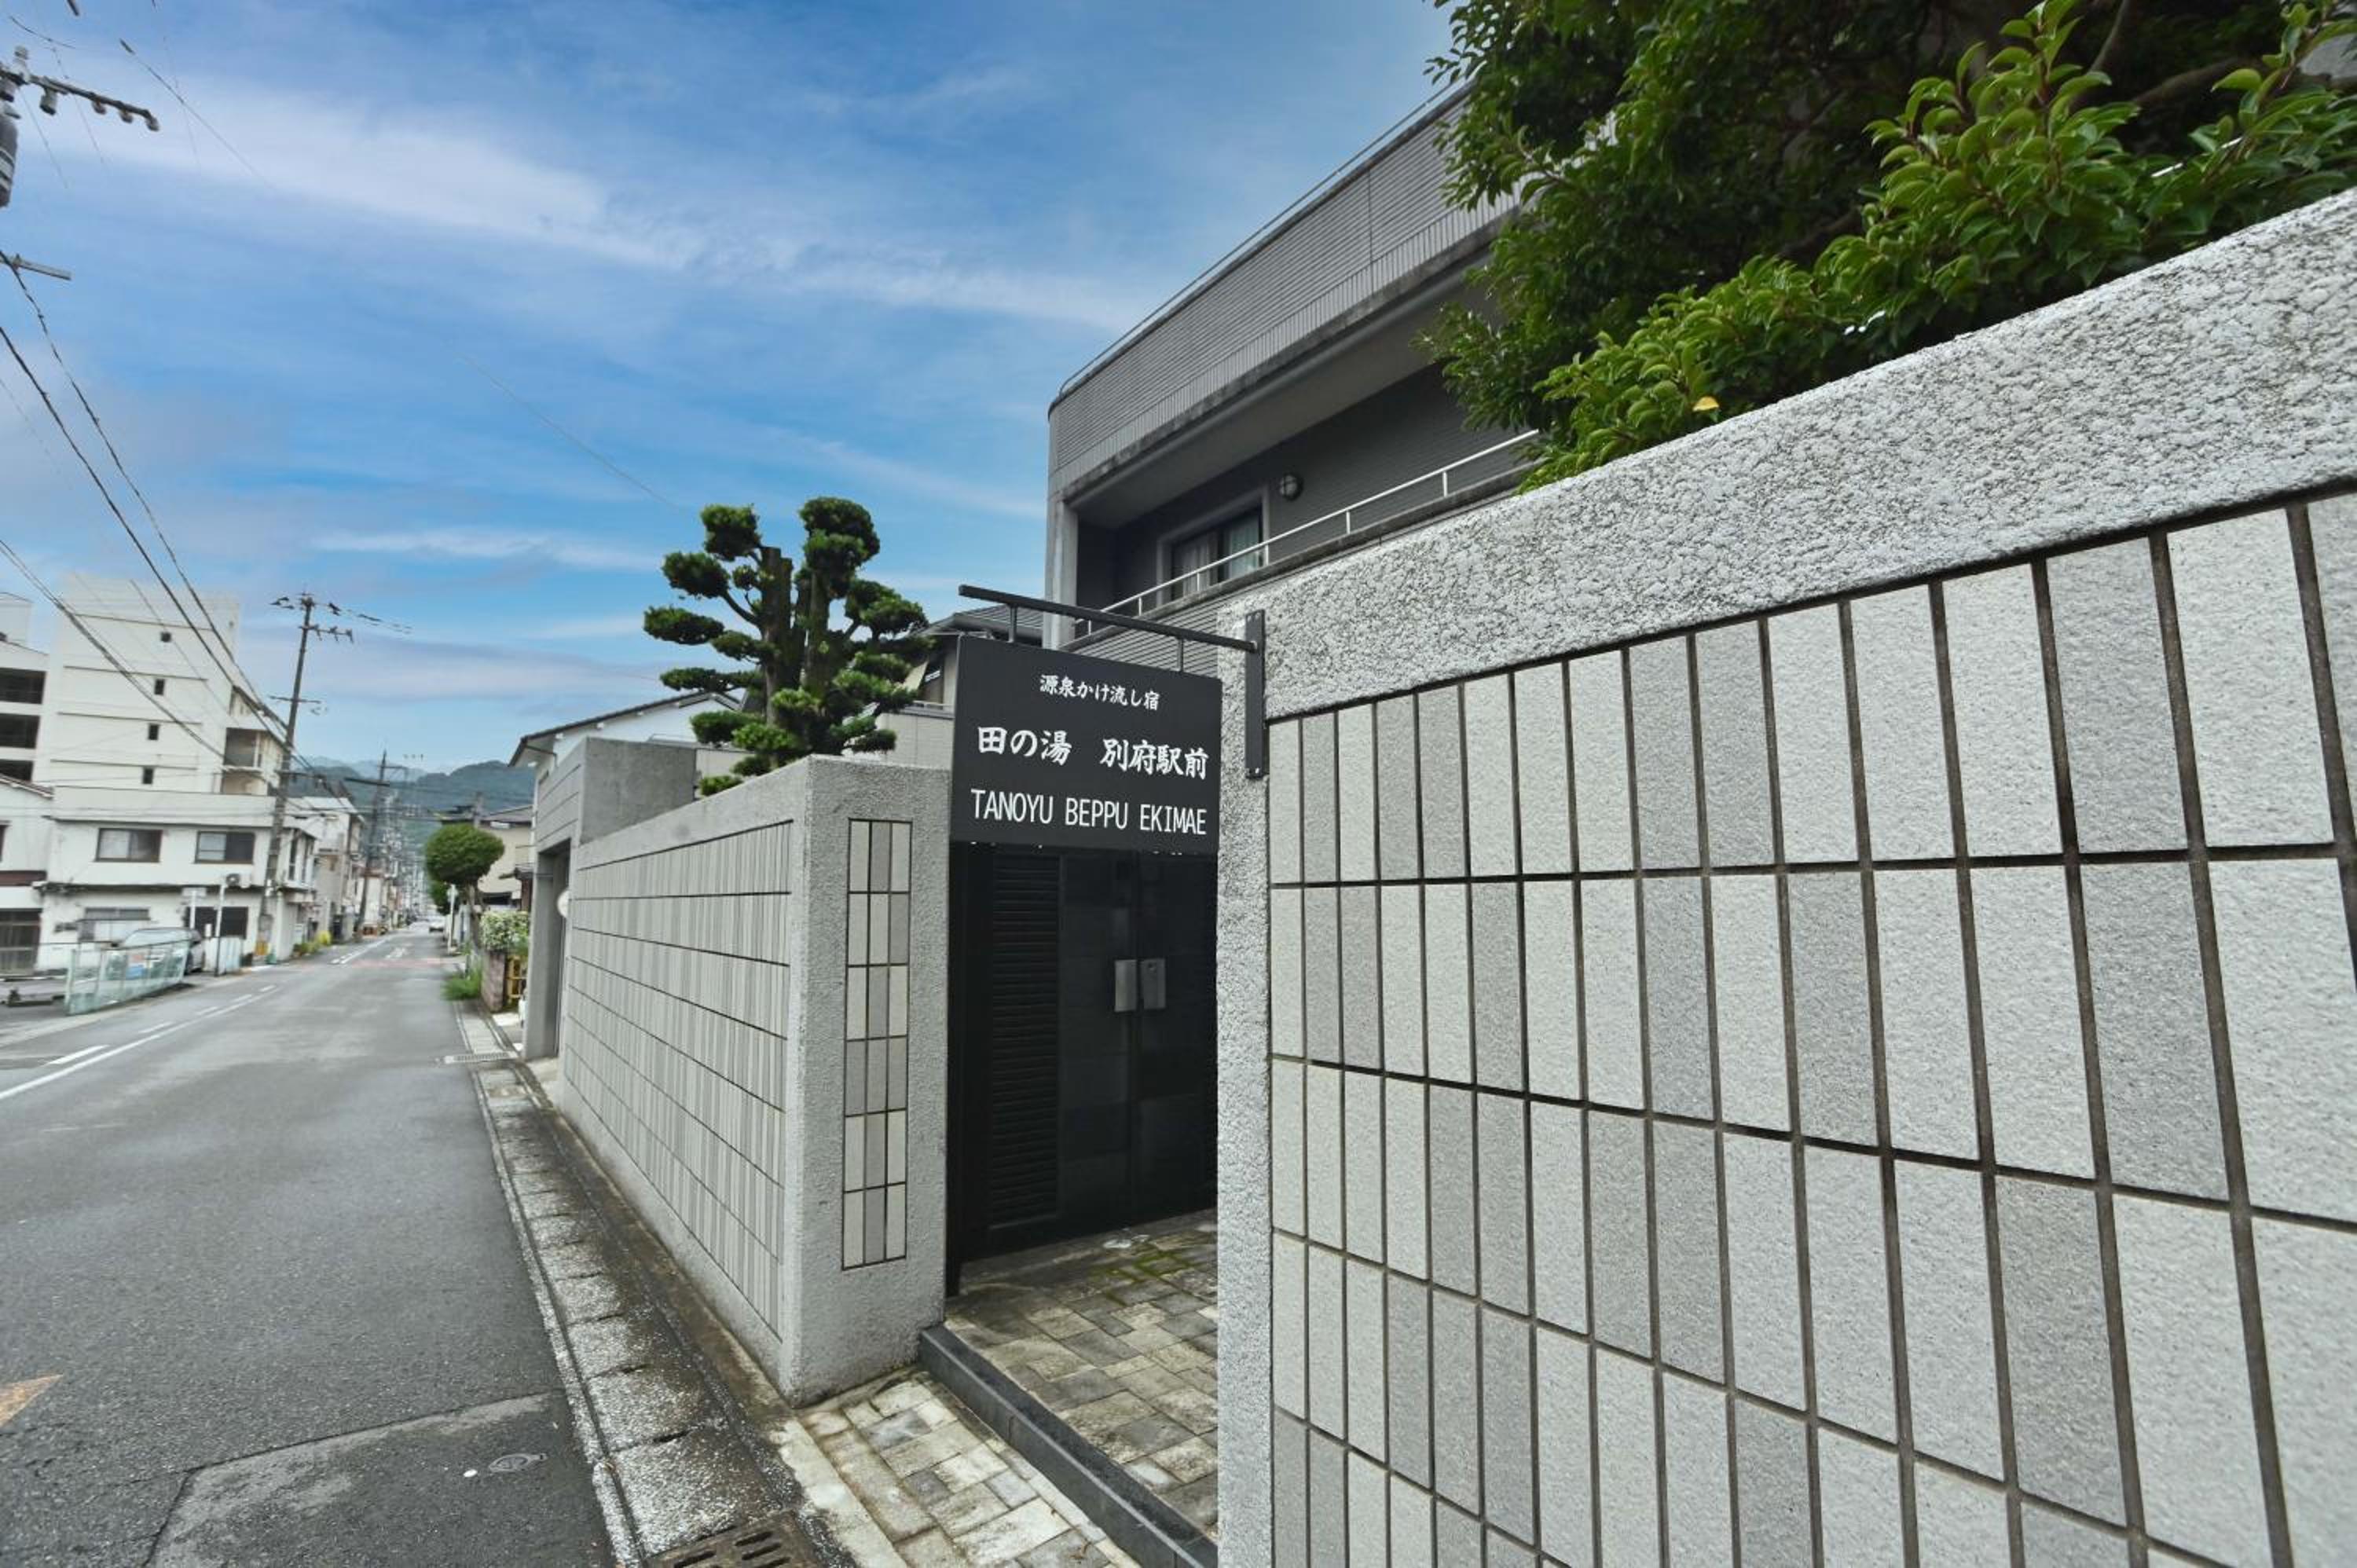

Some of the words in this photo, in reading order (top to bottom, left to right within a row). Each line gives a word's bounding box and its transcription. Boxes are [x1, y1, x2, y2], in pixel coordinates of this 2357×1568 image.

[1039, 674, 1160, 710] 源泉かけ流し宿
[978, 727, 1072, 765] 田の湯
[1100, 738, 1209, 779] 別府駅前
[971, 789, 1054, 824] TANOYU
[1065, 797, 1128, 830] BEPPU
[1140, 804, 1208, 834] EKIMAE
